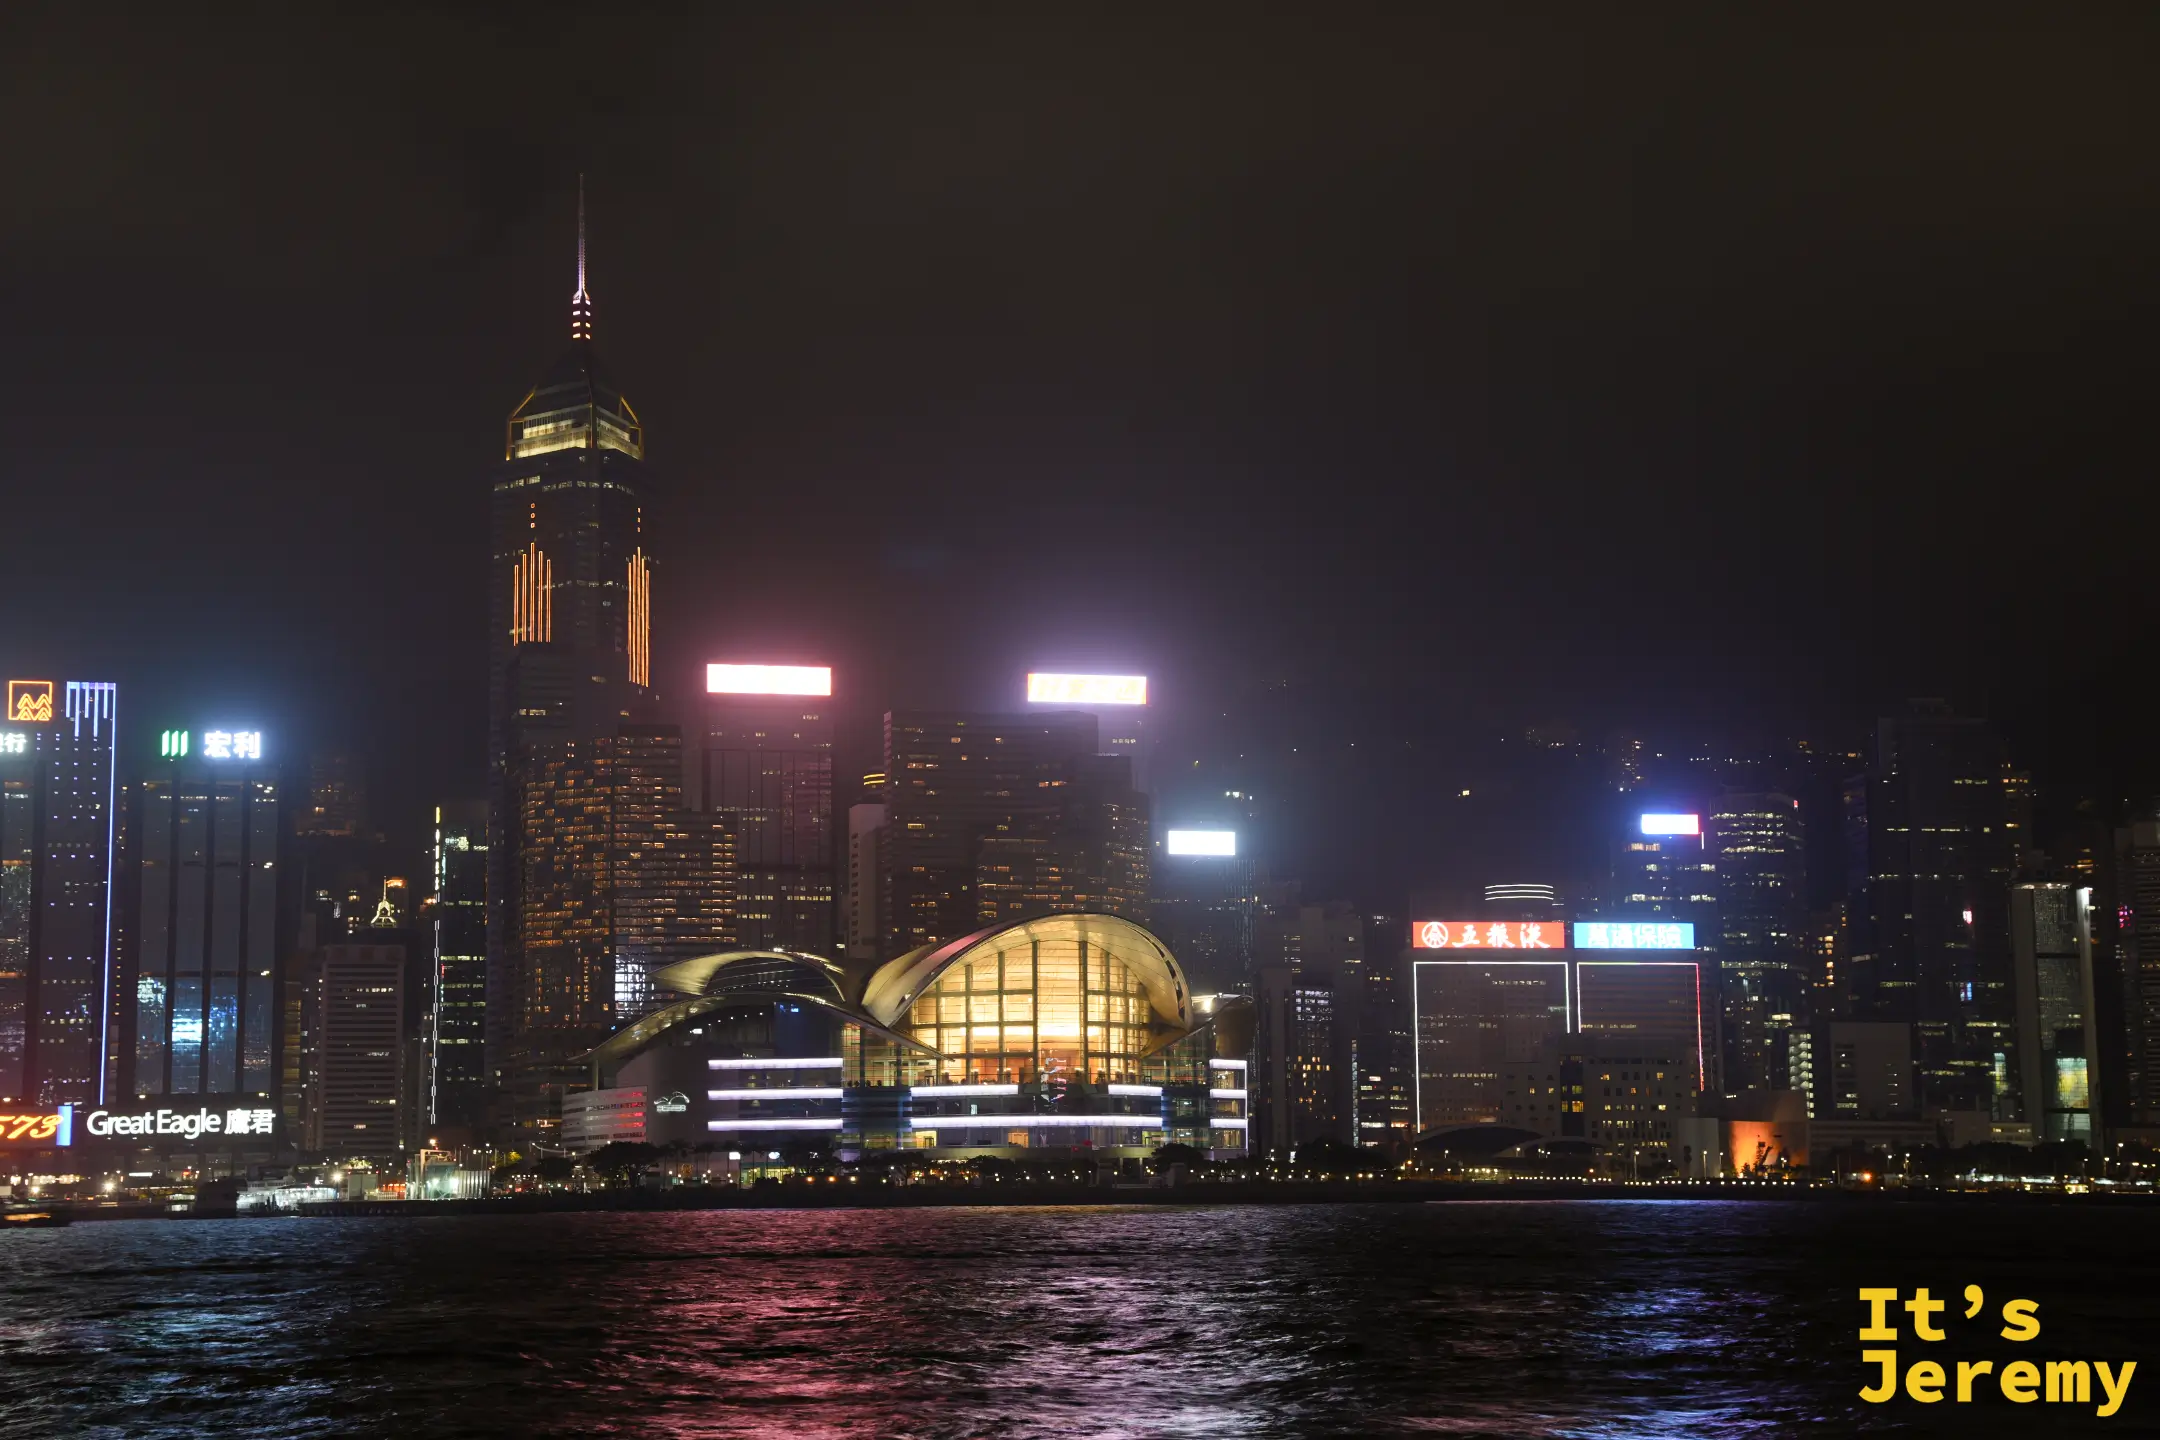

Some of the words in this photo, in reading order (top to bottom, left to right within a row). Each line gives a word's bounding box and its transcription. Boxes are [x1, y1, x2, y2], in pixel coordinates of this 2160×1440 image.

[0, 732, 27, 754] 行
[203, 730, 261, 759] 宏利
[1588, 923, 1682, 948] 萬通保險
[86, 1111, 154, 1135] Great
[156, 1108, 221, 1140] Eagle
